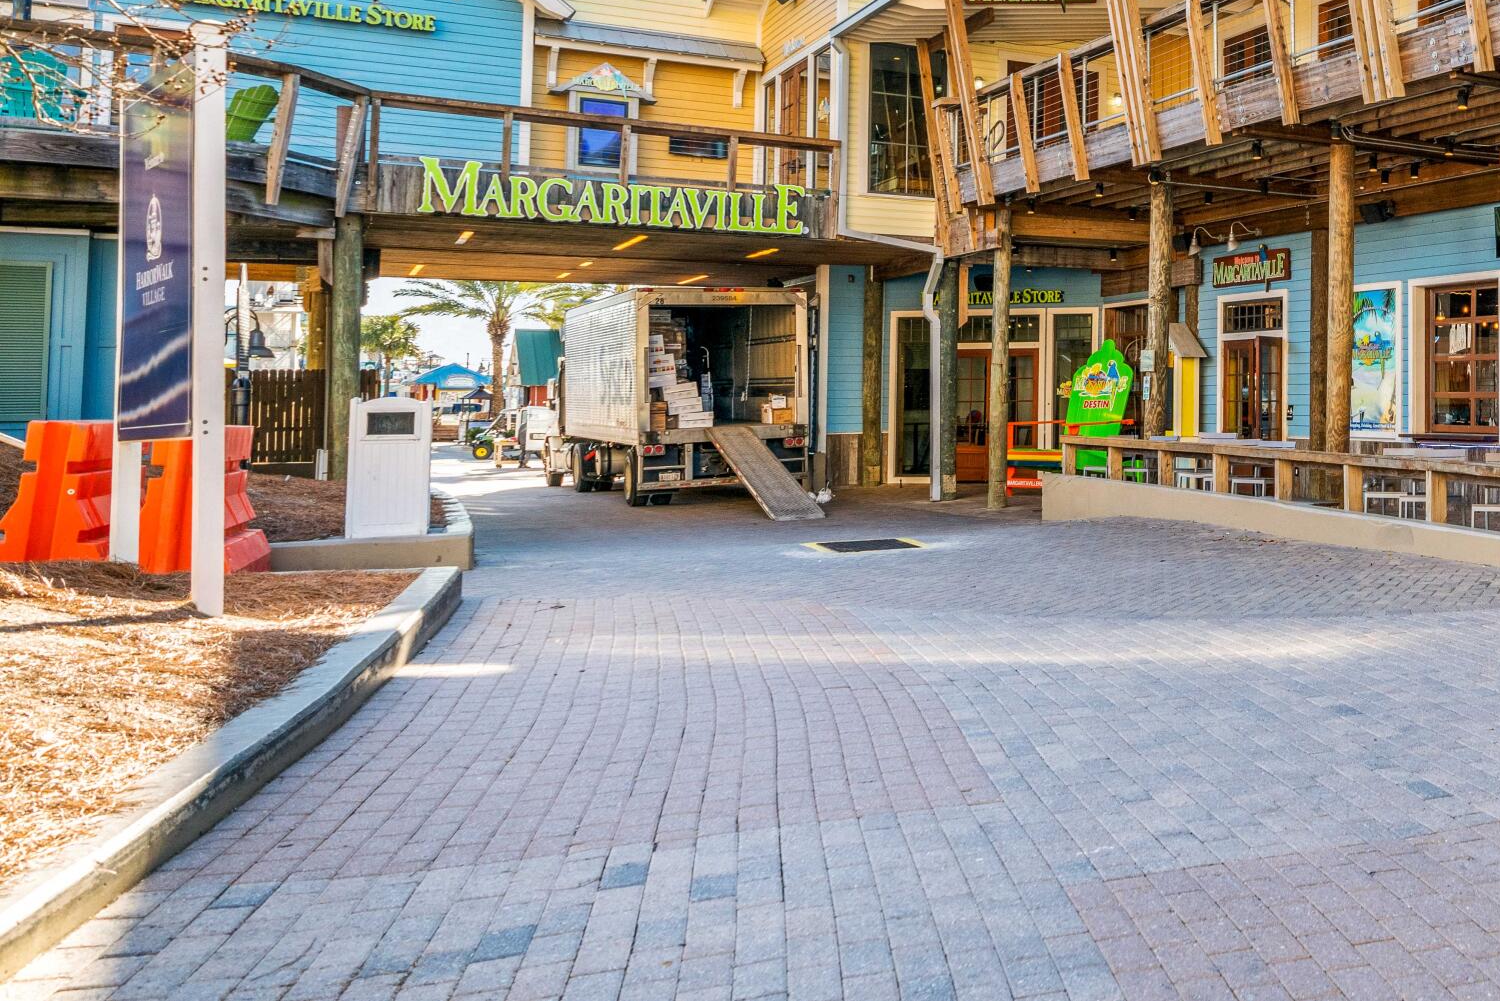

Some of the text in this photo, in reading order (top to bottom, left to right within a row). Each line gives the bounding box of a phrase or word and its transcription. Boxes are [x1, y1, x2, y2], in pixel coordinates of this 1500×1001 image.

[365, 4, 437, 32] STORE
[416, 155, 805, 235] MARGARITAVILLE
[1213, 253, 1285, 285] MARGARITAVILLE
[655, 297, 665, 305] 28
[1022, 288, 1062, 303] STORE
[1083, 399, 1110, 409] DESTIN
